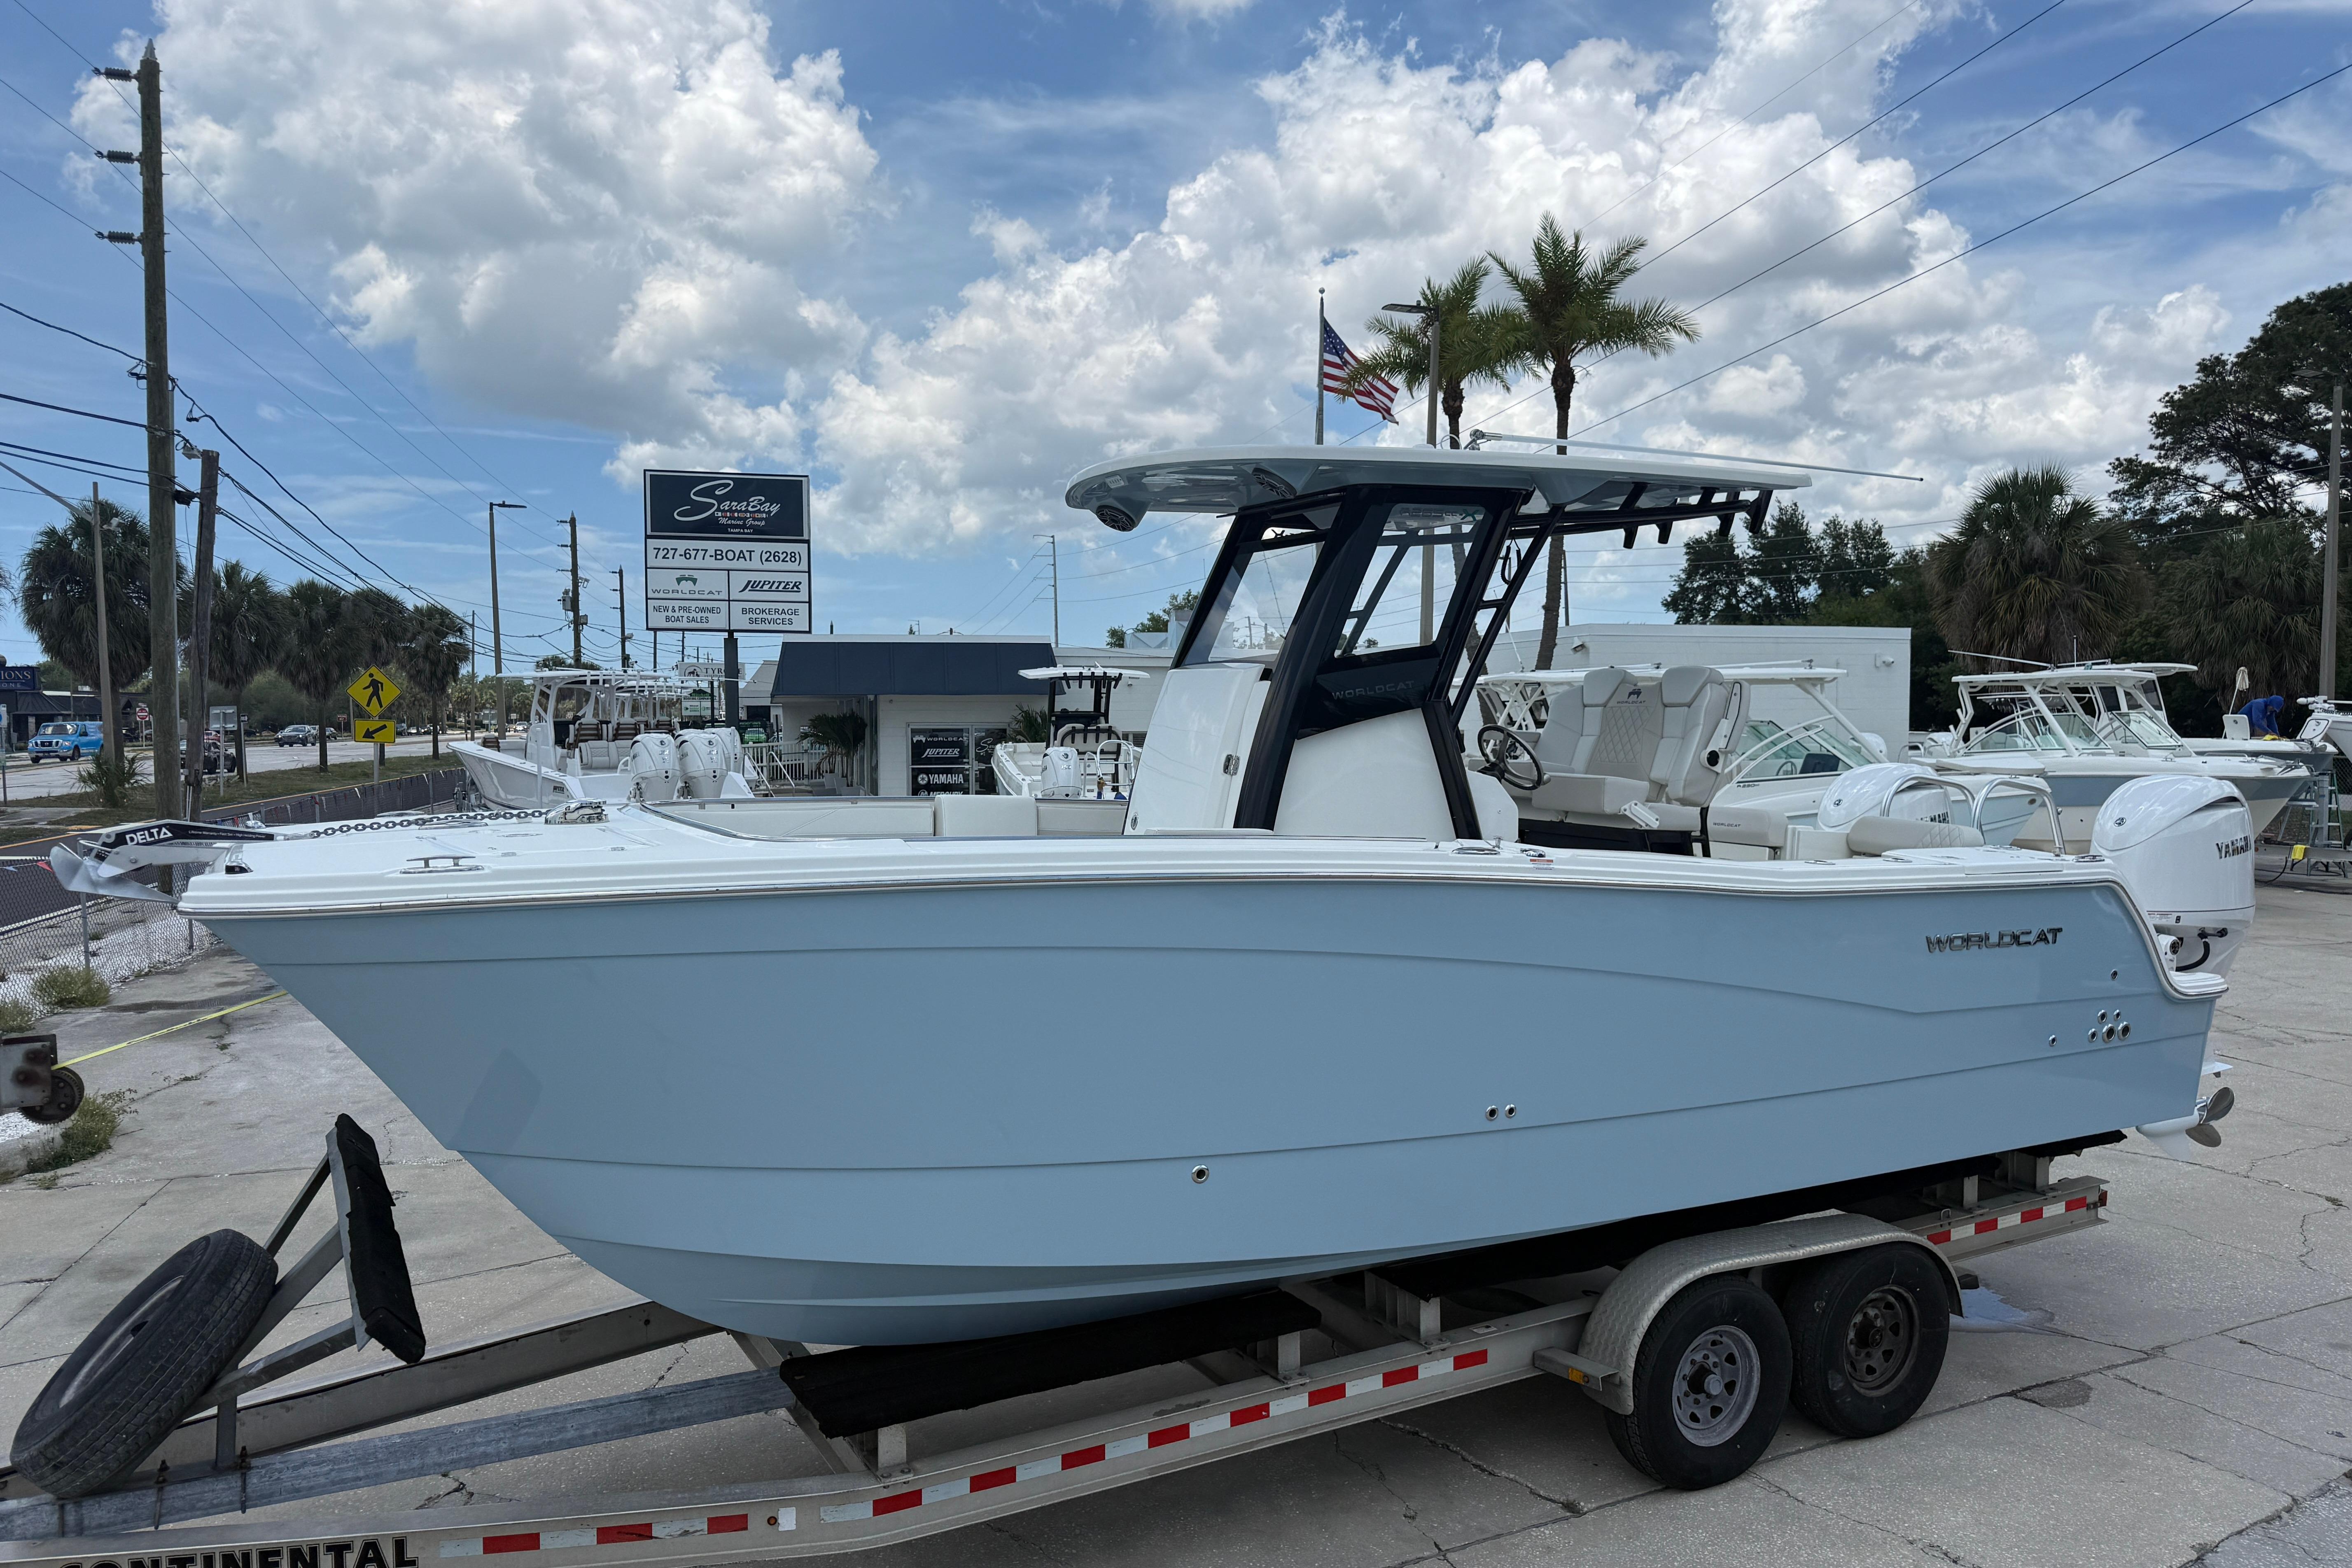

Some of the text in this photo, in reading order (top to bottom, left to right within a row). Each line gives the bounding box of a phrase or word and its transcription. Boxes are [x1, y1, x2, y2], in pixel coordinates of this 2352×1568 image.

[674, 479, 781, 521] SaraBay
[745, 518, 766, 527] Group
[653, 547, 802, 566] 727-677-BOAT (2628)
[738, 579, 802, 593] JUPITER
[653, 605, 670, 614] NEW
[678, 606, 721, 614] PRE-OWNED
[741, 607, 800, 616] BROKERAGE
[686, 616, 709, 624] SALES
[748, 617, 793, 625] SERVICES
[1332, 680, 1414, 700] WORLDCAT
[921, 749, 960, 758] JUPITER
[929, 774, 964, 784] YAMAHA
[126, 827, 173, 845] DELTA
[1925, 927, 2063, 954] WORLDCAT
[59, 1536, 419, 1568] INENTAL
